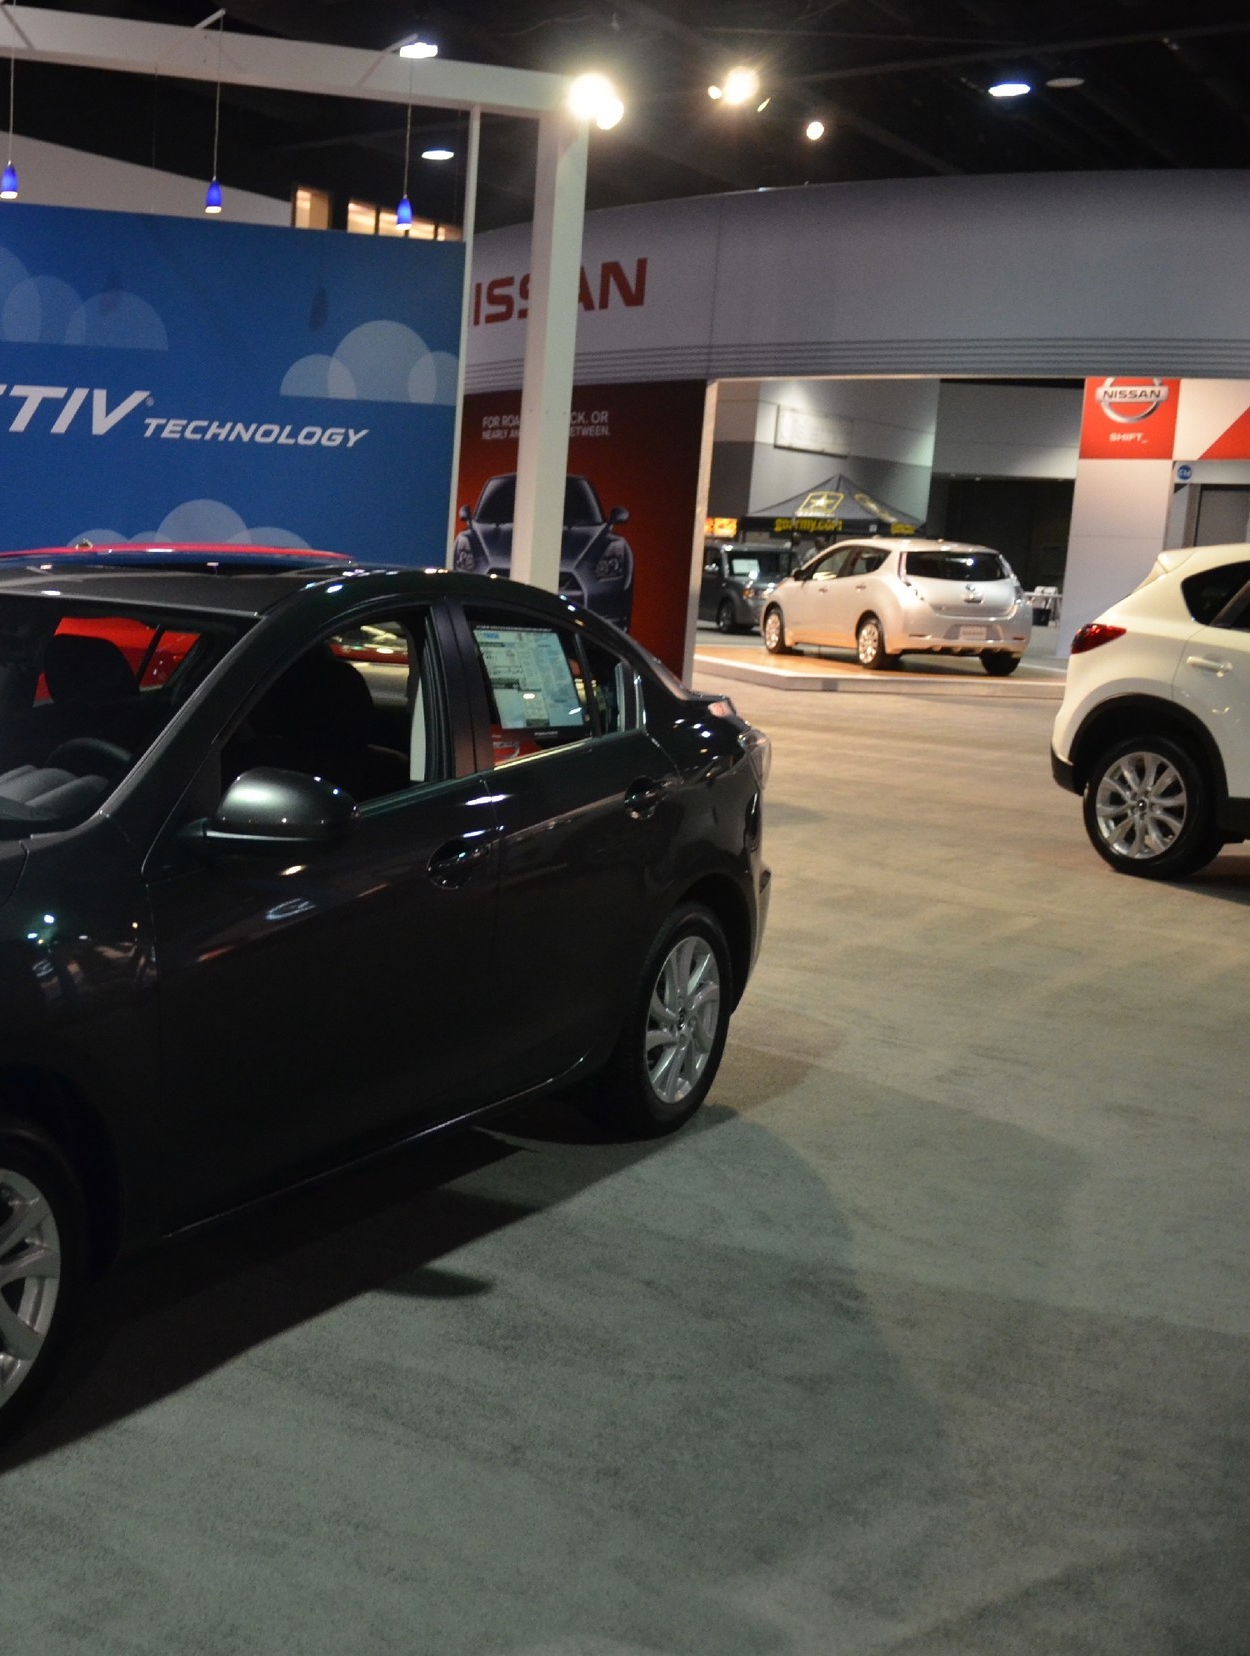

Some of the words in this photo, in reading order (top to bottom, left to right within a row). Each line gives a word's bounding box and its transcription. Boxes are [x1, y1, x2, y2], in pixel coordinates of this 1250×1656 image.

[473, 257, 649, 327] ISN
[1102, 389, 1162, 399] NISSAN
[482, 416, 500, 428] FOR
[501, 414, 520, 427] ROA
[591, 410, 609, 424] OR
[143, 417, 370, 448] TECHNOLOGY
[569, 425, 611, 437] ETWEEN.
